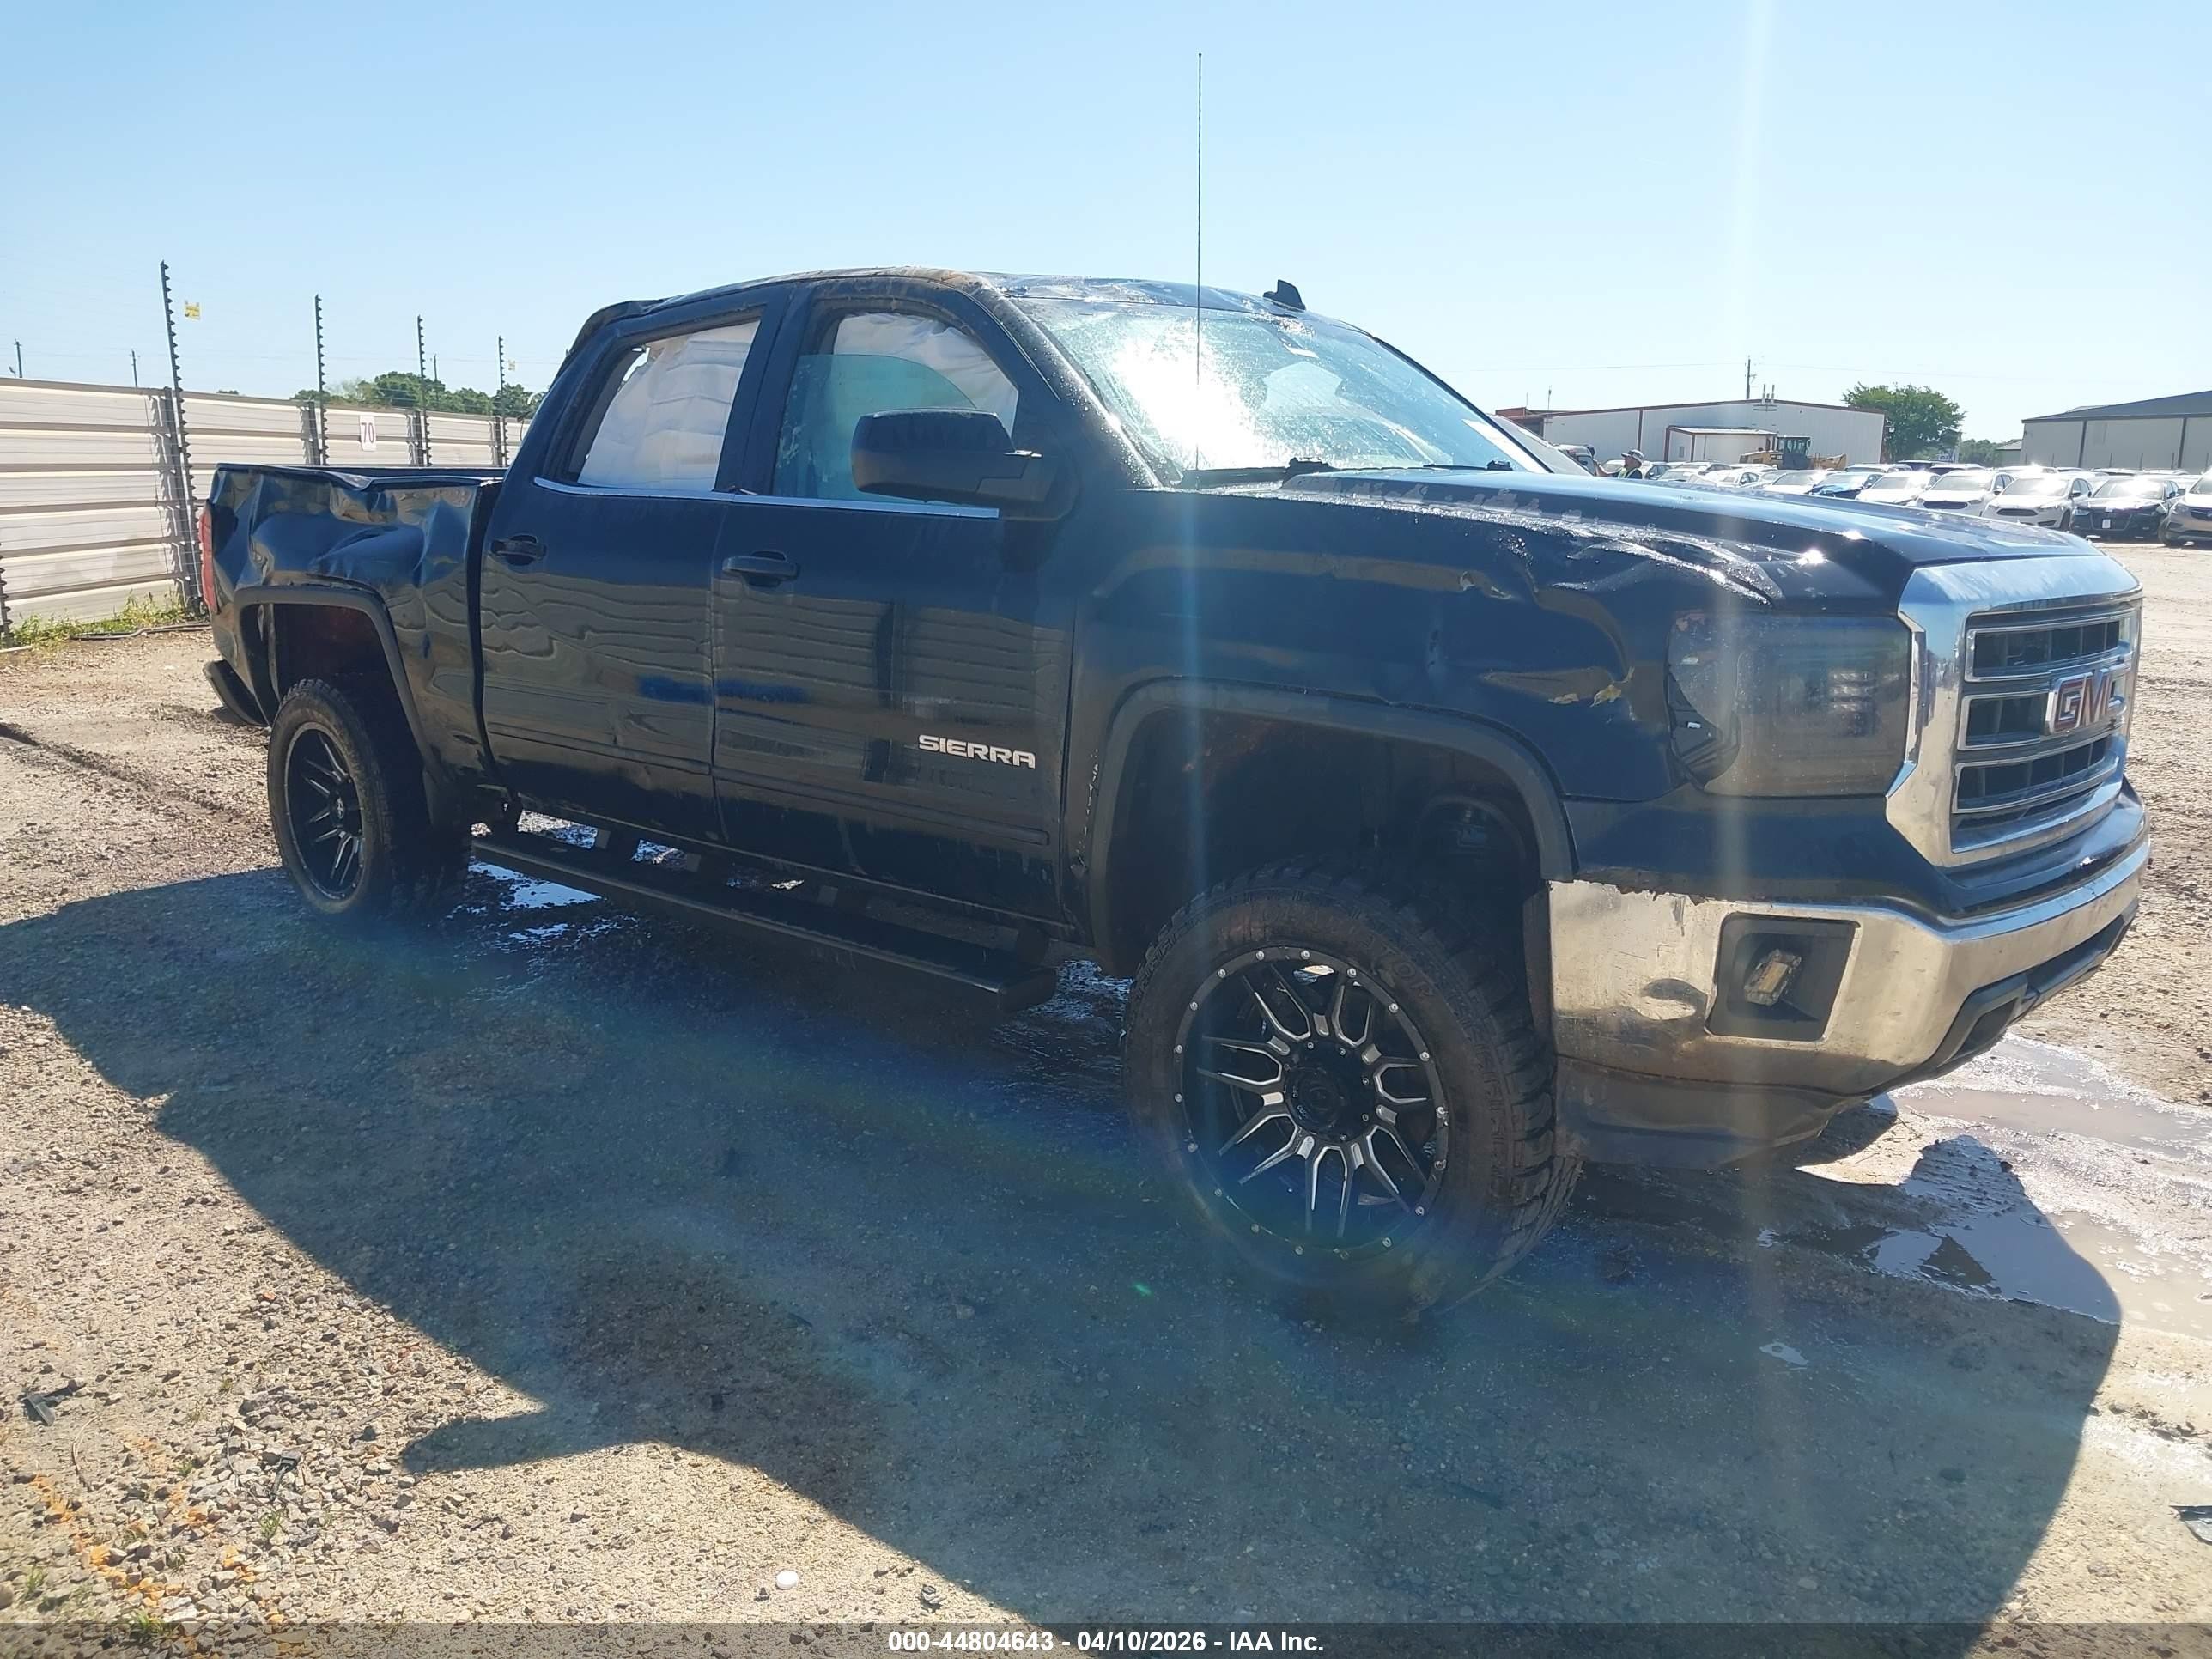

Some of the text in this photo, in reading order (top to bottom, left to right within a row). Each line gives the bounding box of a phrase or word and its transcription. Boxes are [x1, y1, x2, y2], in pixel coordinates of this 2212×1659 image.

[361, 422, 374, 443] 70
[2045, 662, 2131, 734] GMC
[919, 734, 1036, 769] SIERRA
